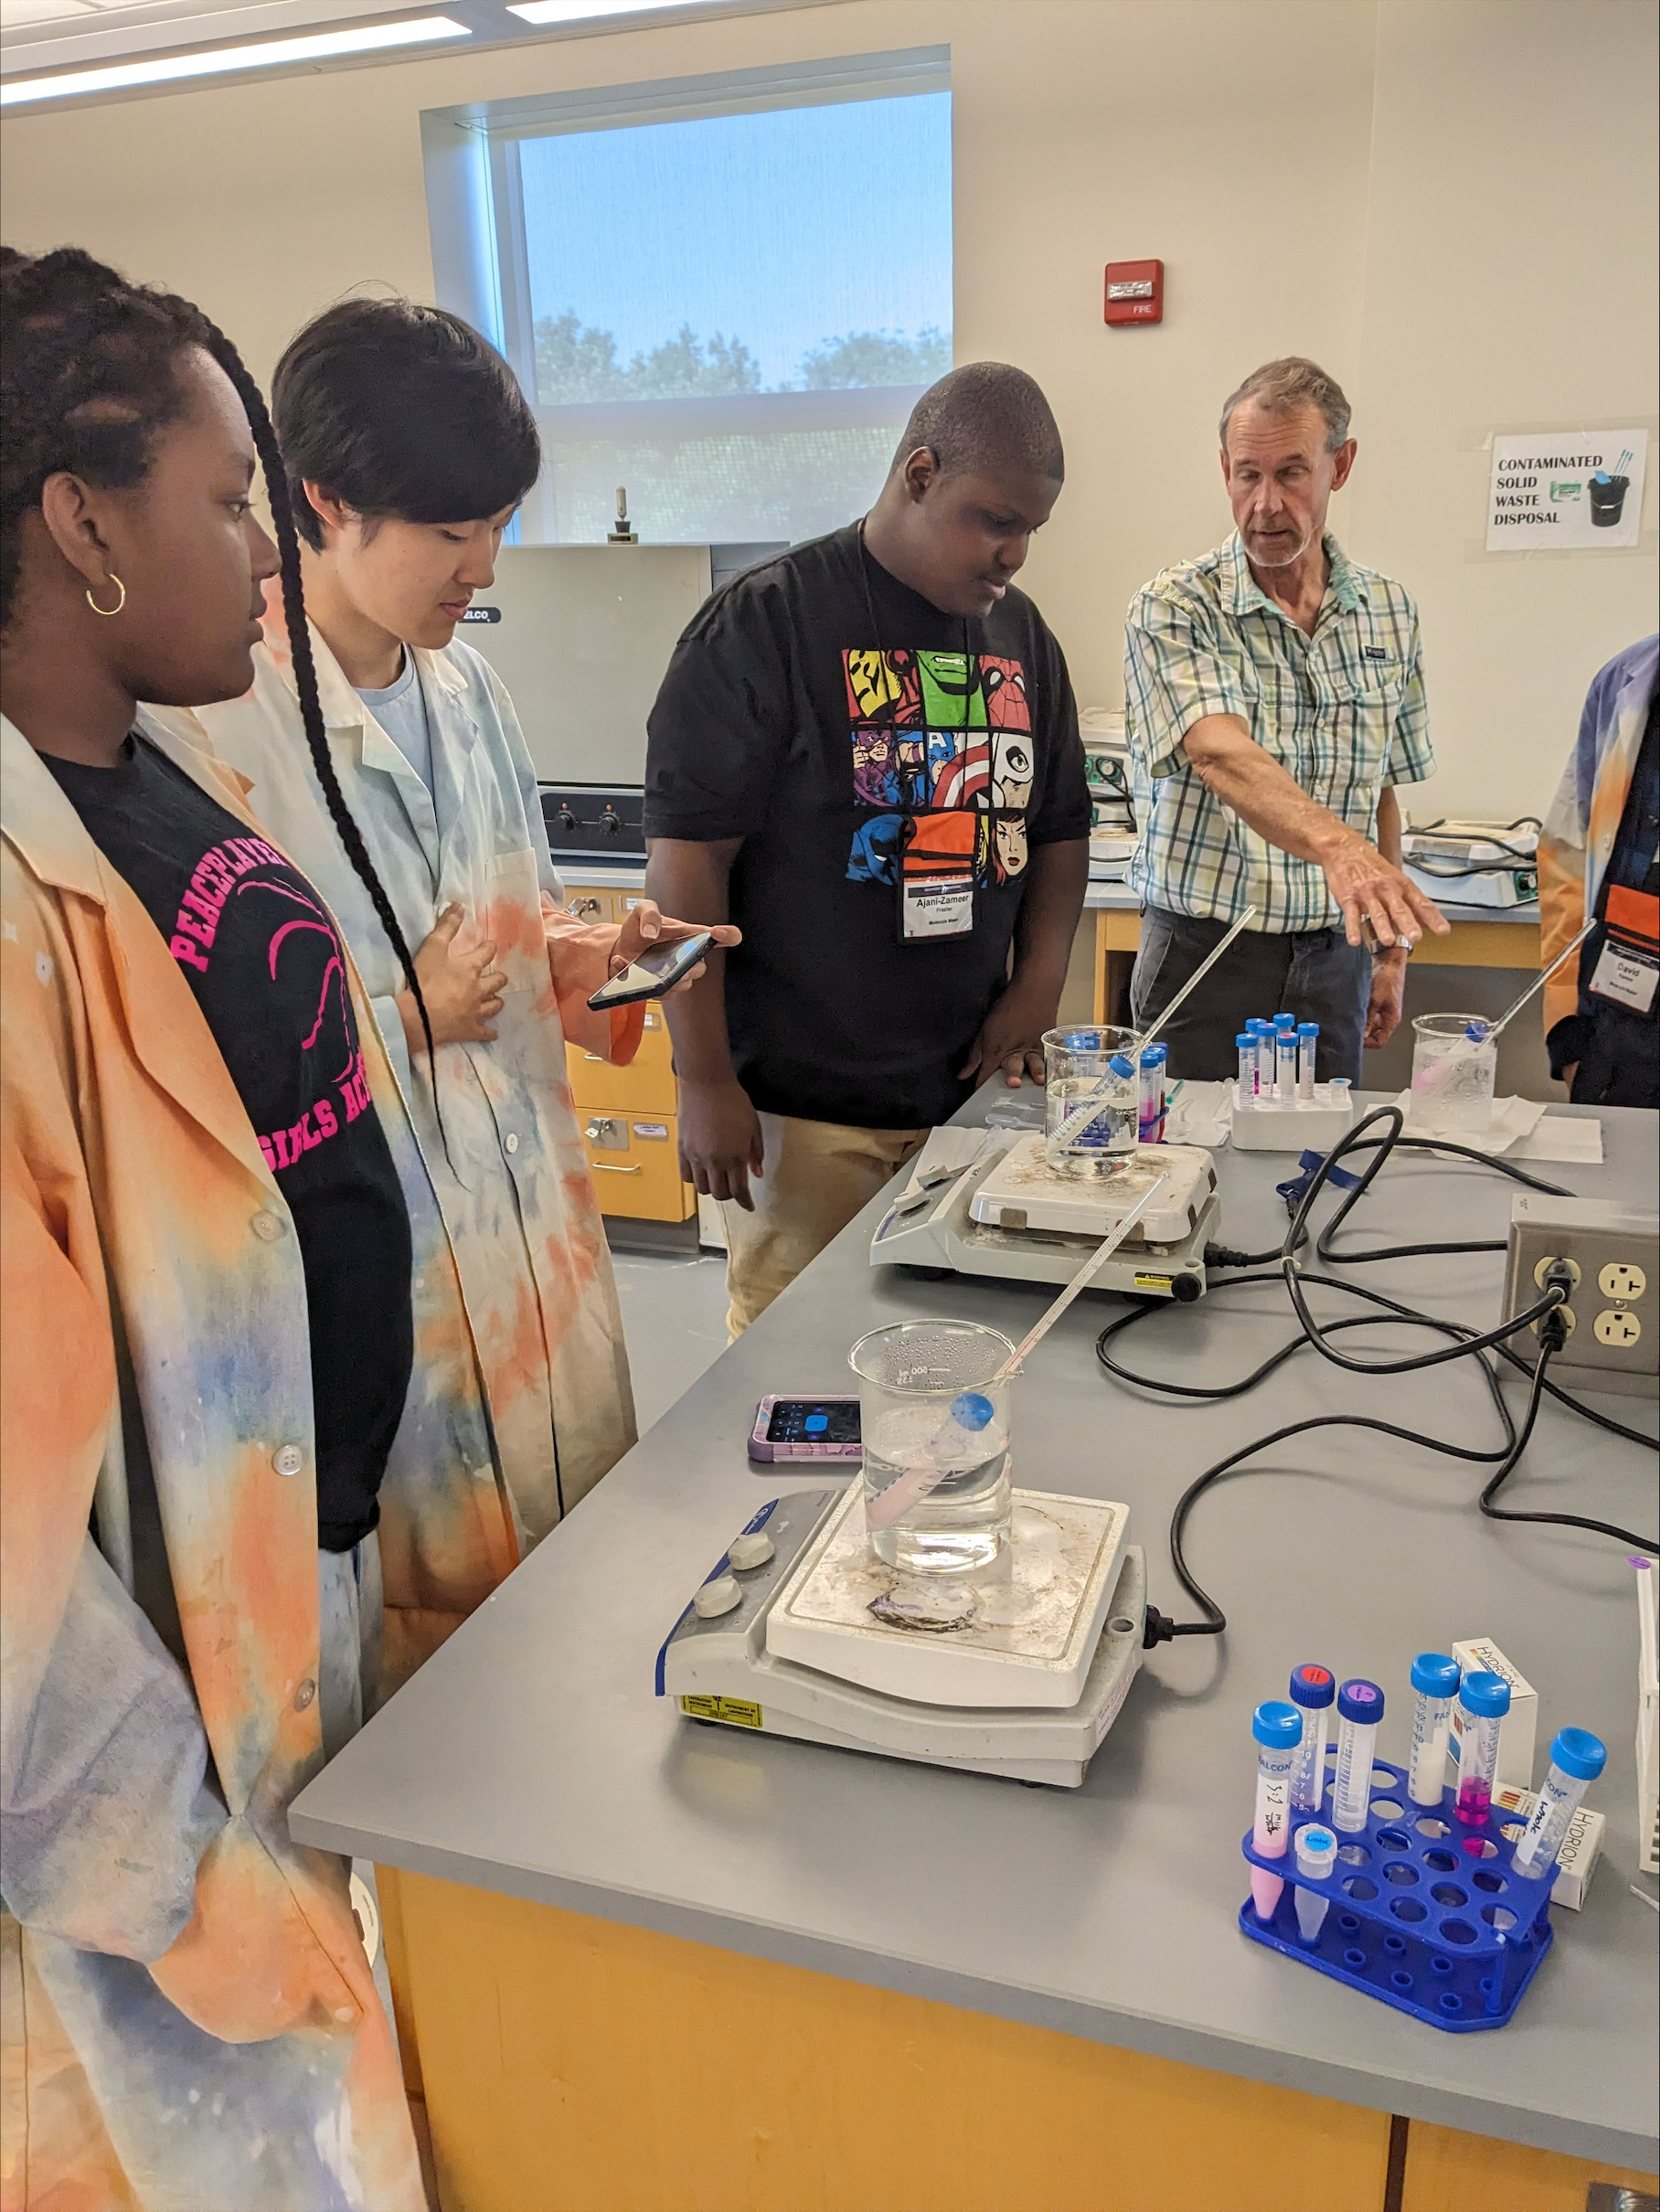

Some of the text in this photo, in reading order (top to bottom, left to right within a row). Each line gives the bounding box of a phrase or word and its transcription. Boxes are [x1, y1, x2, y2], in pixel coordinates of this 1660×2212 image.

[1133, 304, 1152, 314] FIRE
[1498, 455, 1603, 471] CONTAMINATED
[1496, 476, 1538, 489] SOLID
[1495, 495, 1540, 506] WASTE
[1494, 512, 1561, 526] DISPOSAL
[463, 610, 489, 620] ELCO
[928, 731, 947, 750] A
[169, 837, 290, 973] PEACEPLAYE
[916, 895, 969, 908] Ajani-Zameer
[1617, 962, 1641, 977] David
[257, 1099, 339, 1173] GIRLS
[1557, 1811, 1594, 1870] HYDRION
